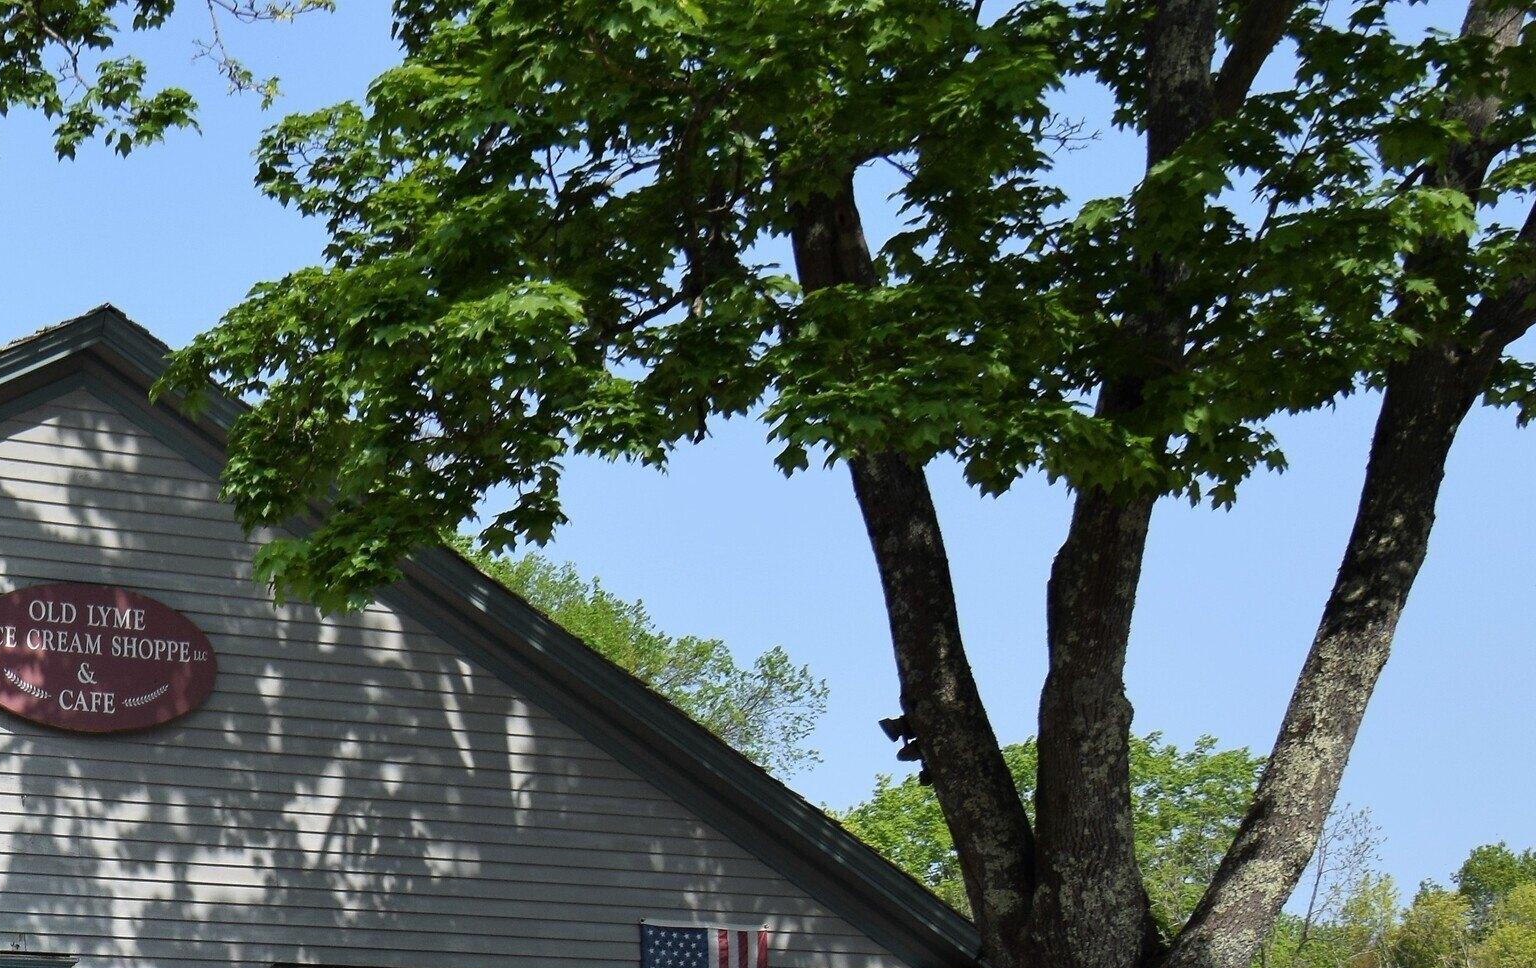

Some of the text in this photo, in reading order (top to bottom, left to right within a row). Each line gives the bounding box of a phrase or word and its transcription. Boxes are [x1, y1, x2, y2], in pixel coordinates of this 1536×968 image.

[28, 600, 146, 630] OLD LYME
[26, 628, 102, 655] CREAM
[111, 635, 191, 663] SHOPPE
[193, 650, 208, 661] LLC
[77, 662, 97, 684] &
[58, 689, 116, 714] CAFE
